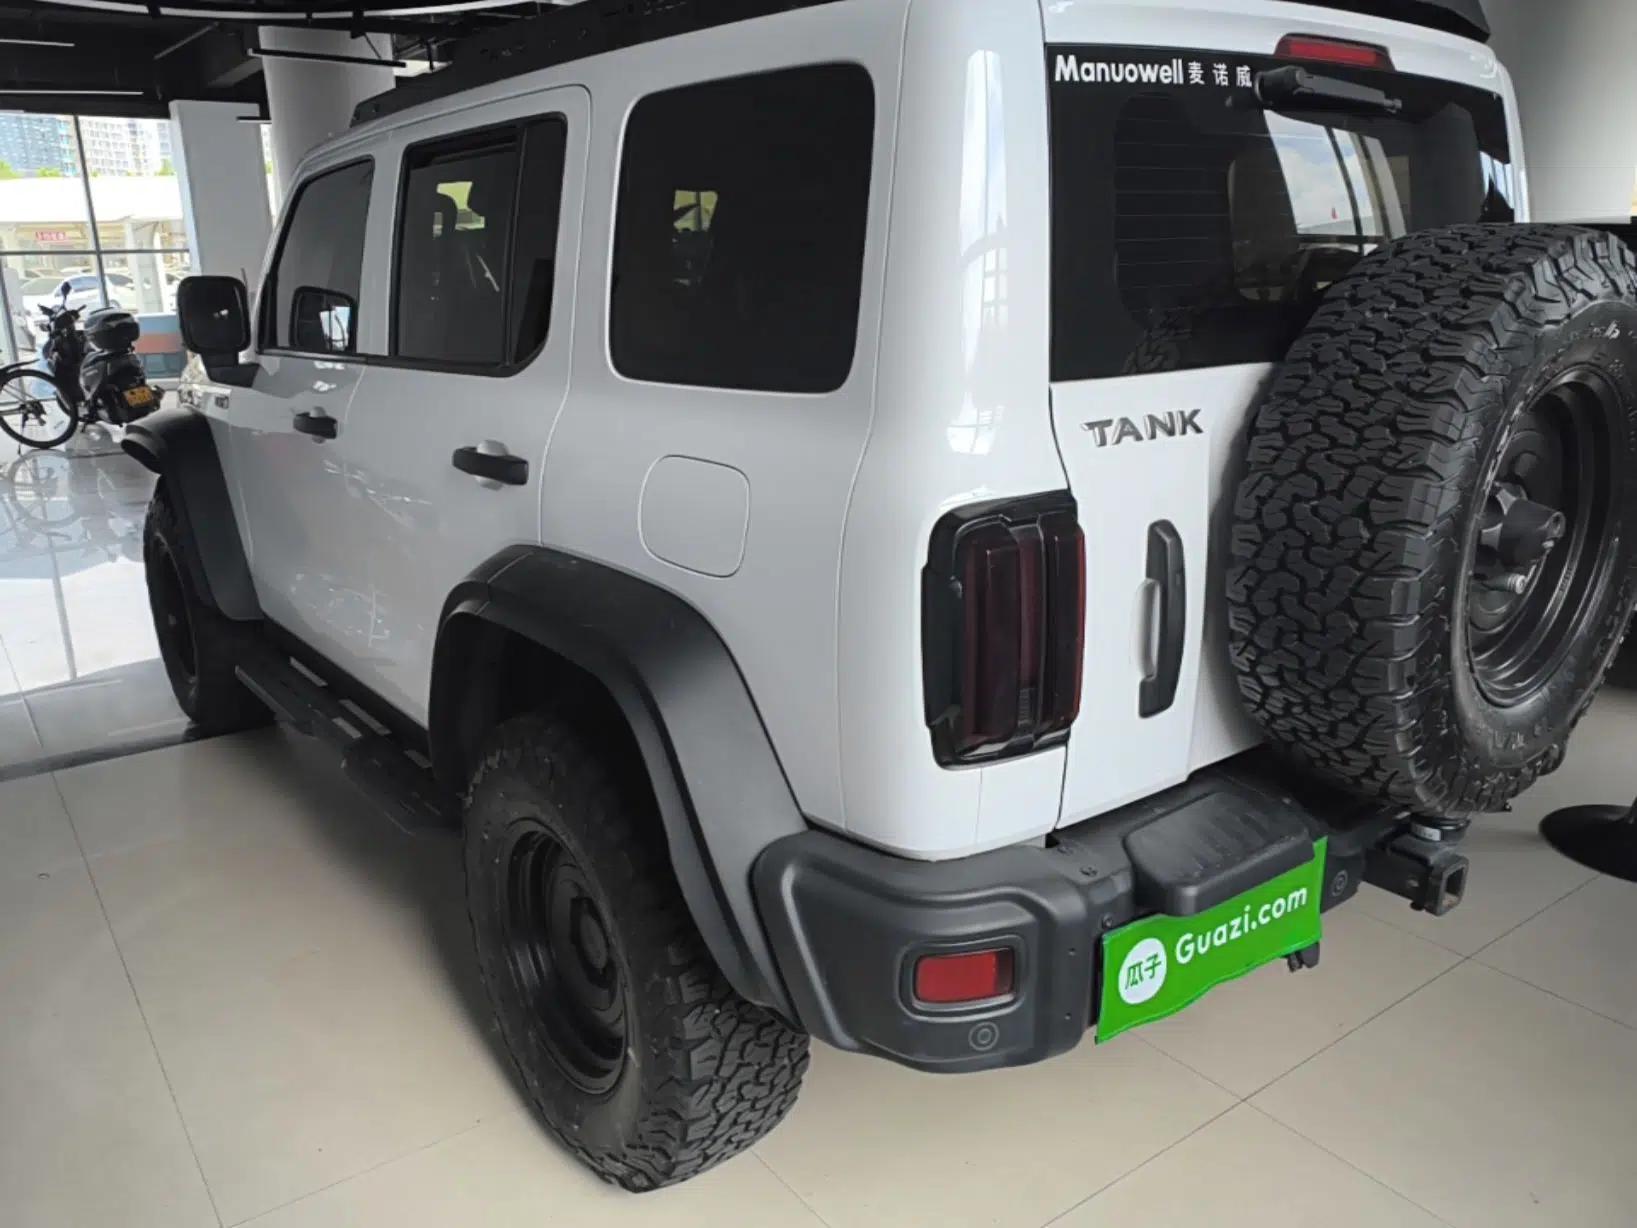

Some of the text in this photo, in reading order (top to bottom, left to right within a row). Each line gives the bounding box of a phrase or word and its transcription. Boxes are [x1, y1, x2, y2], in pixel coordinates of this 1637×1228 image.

[1054, 54, 1253, 88] Manuowell 麦诺威
[1080, 408, 1204, 447] TANK
[1124, 887, 1308, 990] 瓜子 Guazi.com
